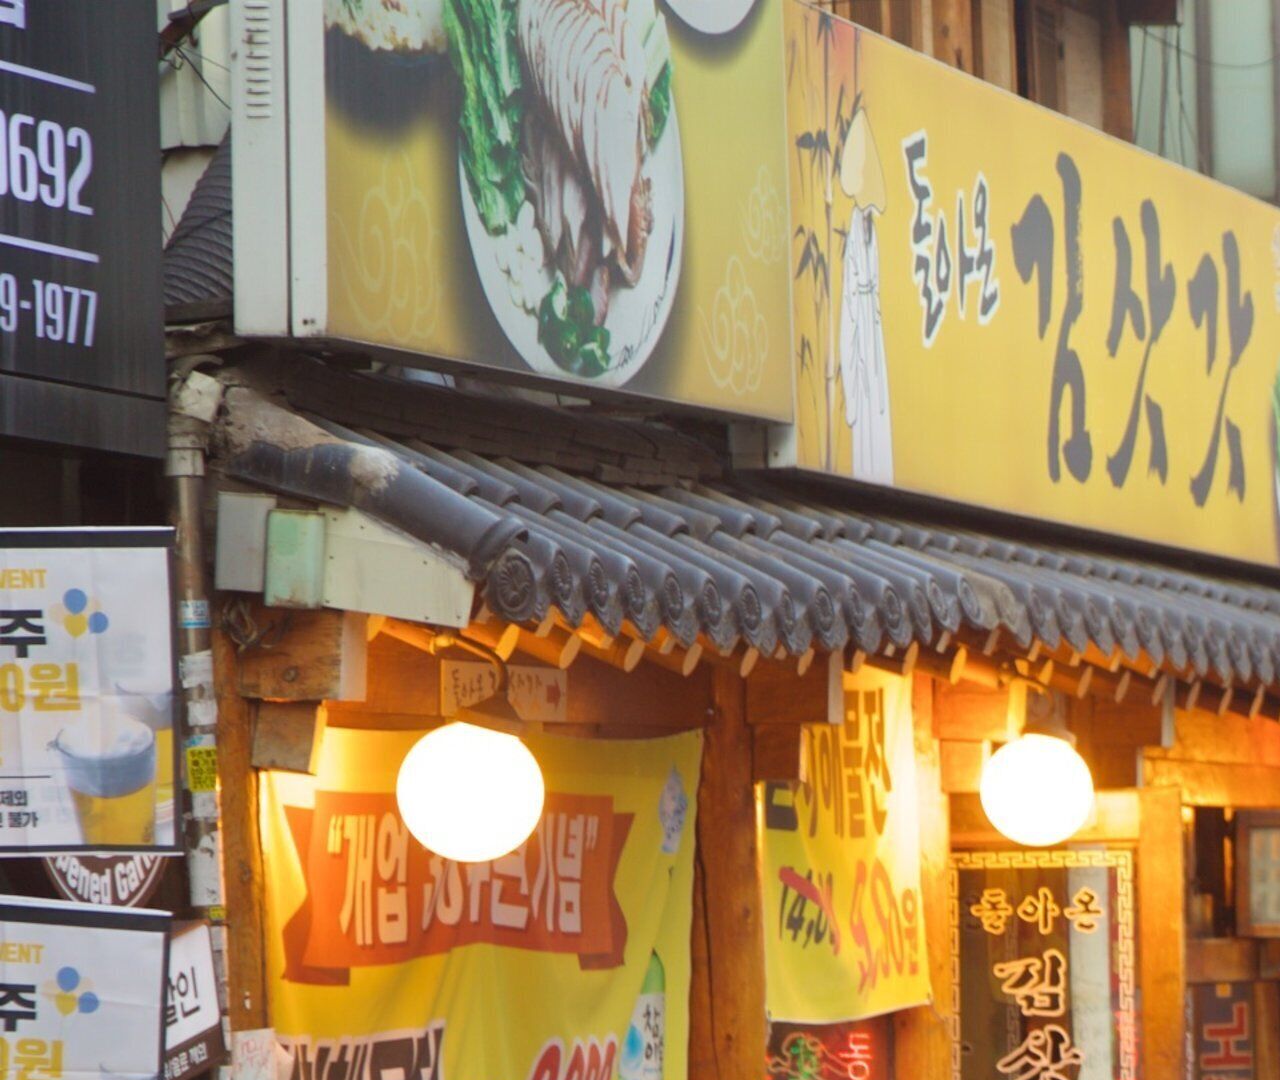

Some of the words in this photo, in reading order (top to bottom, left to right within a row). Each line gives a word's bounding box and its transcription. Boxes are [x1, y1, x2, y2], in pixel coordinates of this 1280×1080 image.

[902, 130, 1002, 348] 돌아온
[1010, 150, 1257, 508] 김삿갓
[970, 887, 1105, 935] 돌아온
